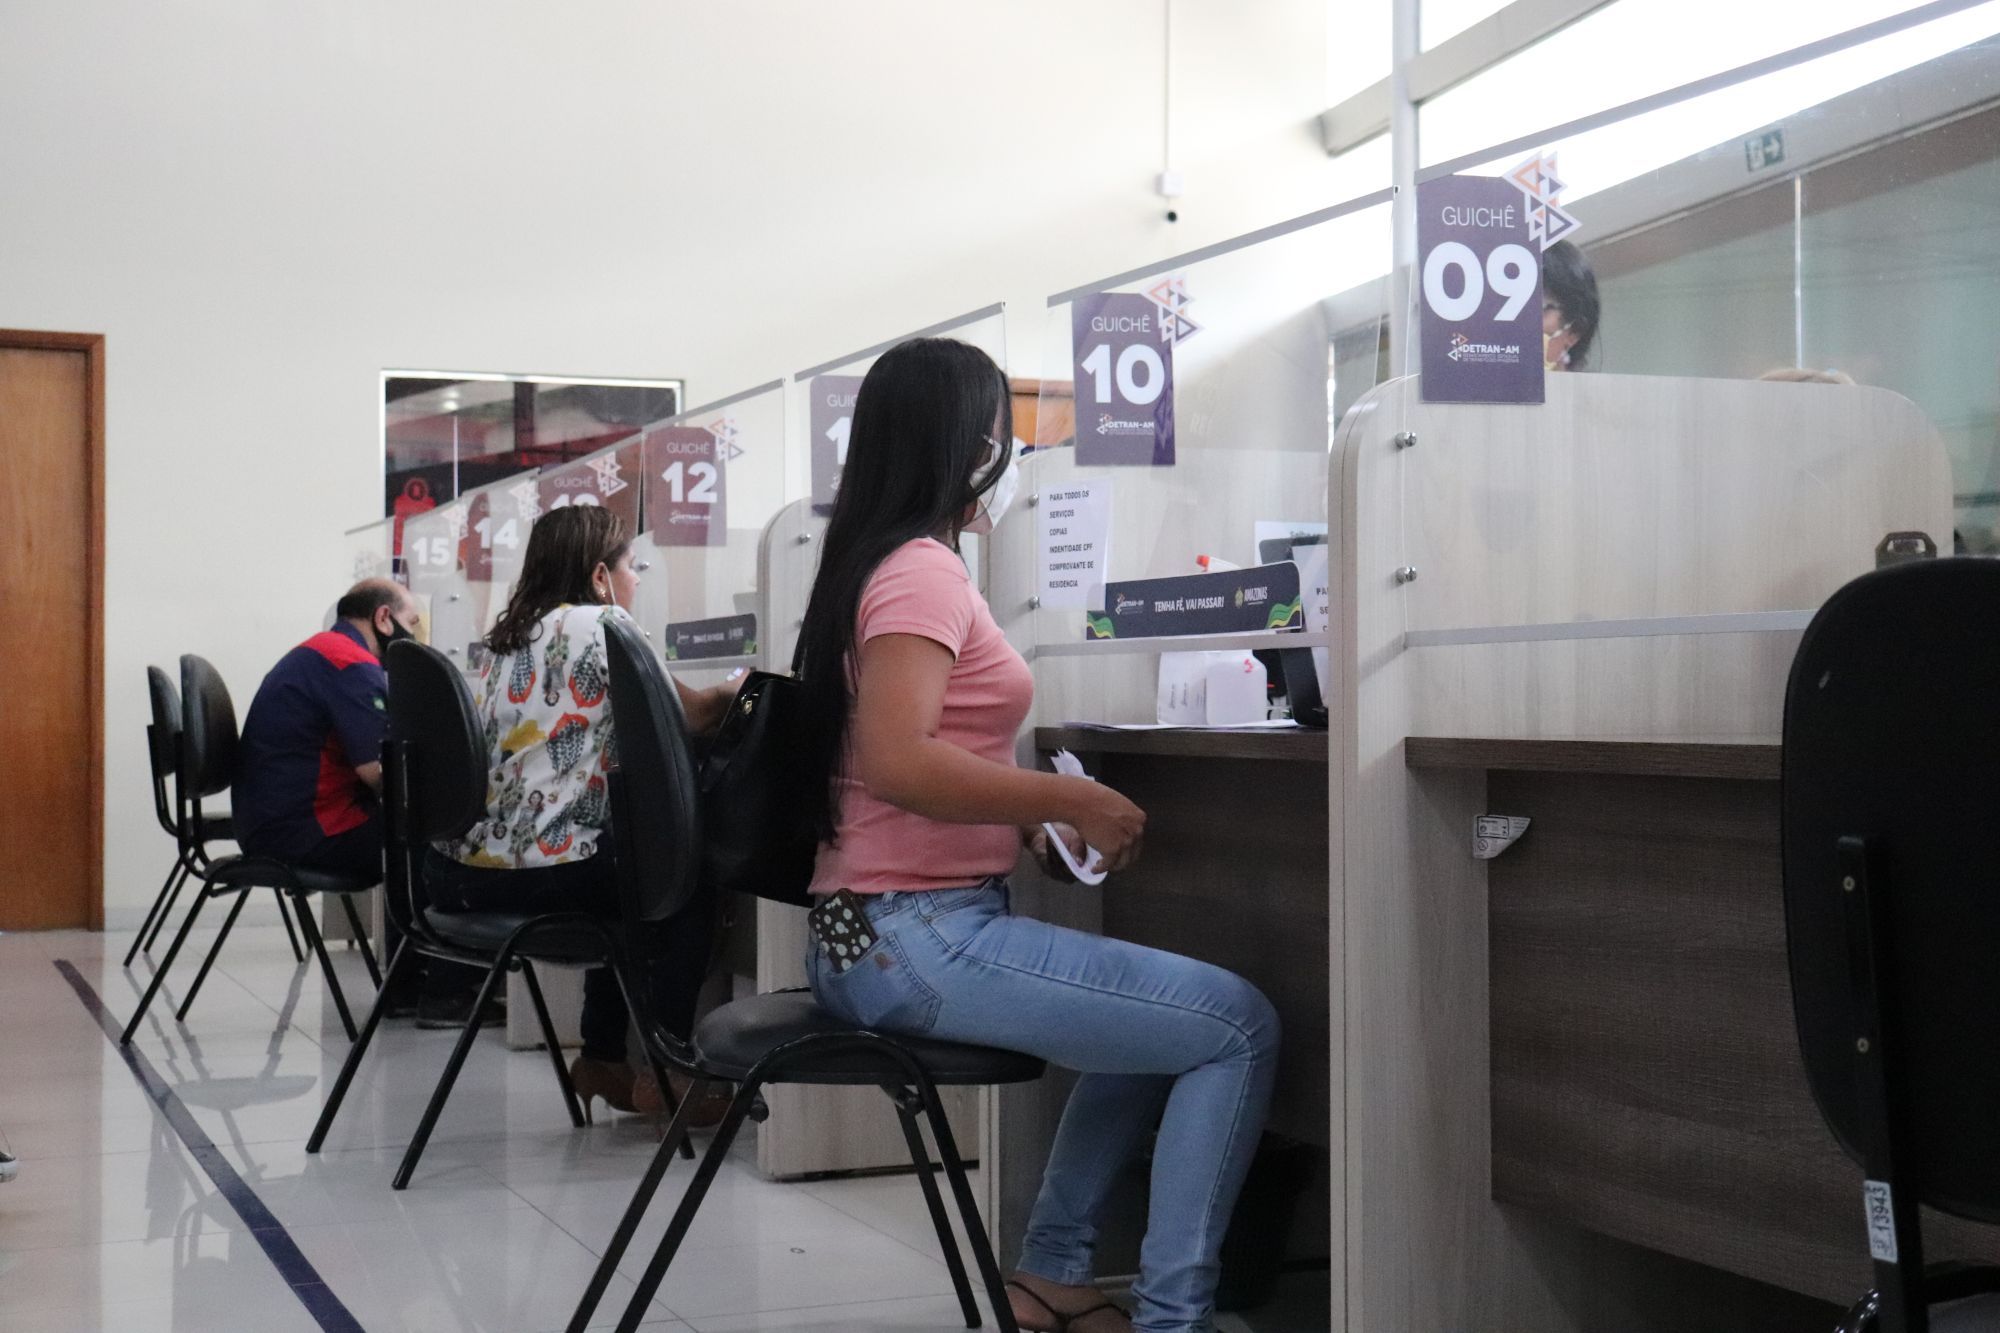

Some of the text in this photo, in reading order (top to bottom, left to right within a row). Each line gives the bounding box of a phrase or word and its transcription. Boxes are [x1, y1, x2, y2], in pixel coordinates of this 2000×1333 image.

[1441, 204, 1515, 228] GUICHÊ
[1422, 241, 1538, 321] 09
[1091, 314, 1151, 333] GUICHÊ
[1462, 344, 1520, 354] DETRAN-AM
[1081, 344, 1165, 405] 10
[827, 394, 858, 408] GUIC
[1107, 421, 1155, 429] DETRAN-AM
[666, 441, 710, 455] GUICHÊ
[825, 416, 851, 465] 1
[661, 461, 718, 504] 12
[1049, 490, 1090, 501] PARA TODOS OS
[1049, 509, 1075, 519] SERVIÇOS
[474, 517, 519, 549] 14
[412, 537, 451, 566] 15
[1083, 542, 1093, 551] CPF
[1049, 560, 1094, 571] COMPROVANTE DE
[1244, 586, 1268, 602] AMAZONAS
[1316, 586, 1328, 596] PA
[1154, 600, 1175, 613] TENHA
[1176, 597, 1185, 613] FÉ,
[1186, 597, 1197, 610] VAI
[1197, 596, 1225, 609] PASSAR!
